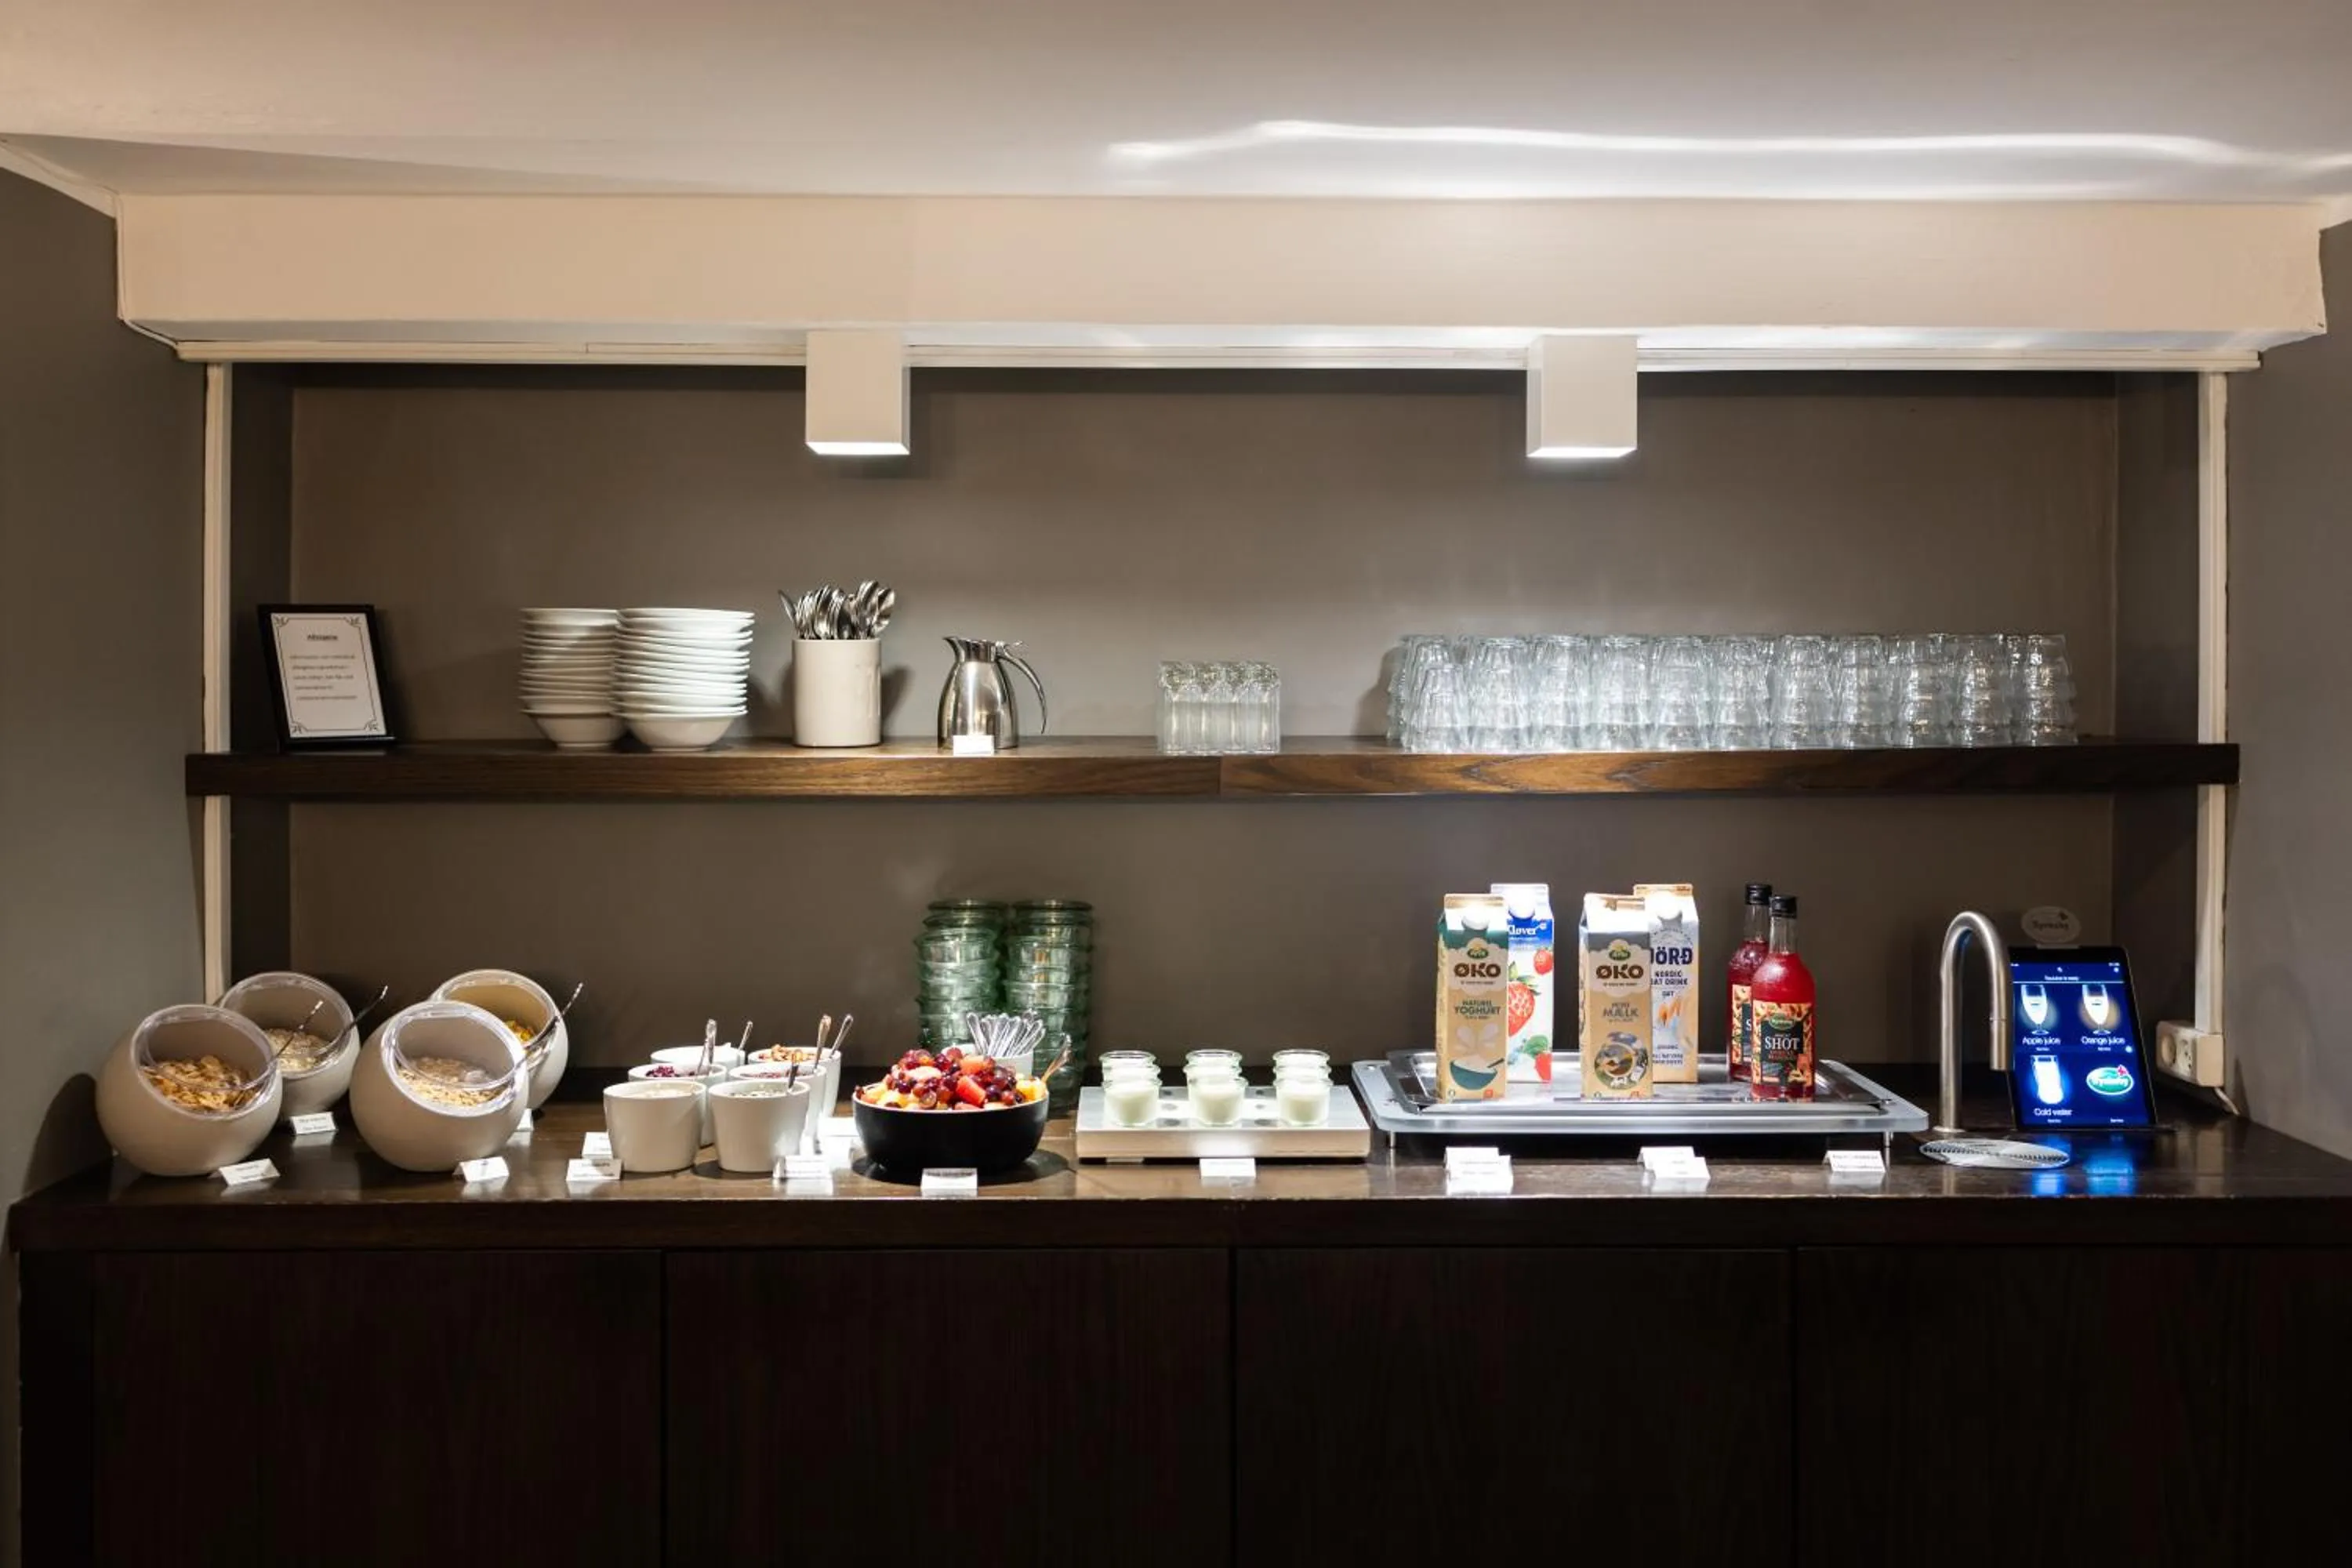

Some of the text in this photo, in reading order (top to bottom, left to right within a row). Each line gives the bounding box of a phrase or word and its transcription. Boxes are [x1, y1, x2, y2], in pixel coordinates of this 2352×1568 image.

[1454, 962, 1501, 978] ØKO
[1595, 963, 1644, 979] ØKO
[1454, 1006, 1501, 1015] YOGHURT
[1765, 1036, 1800, 1050] SHOT
[2022, 1036, 2061, 1045] Apple juice
[2081, 1036, 2125, 1045] Orange juice
[2034, 1108, 2052, 1116] Cold
